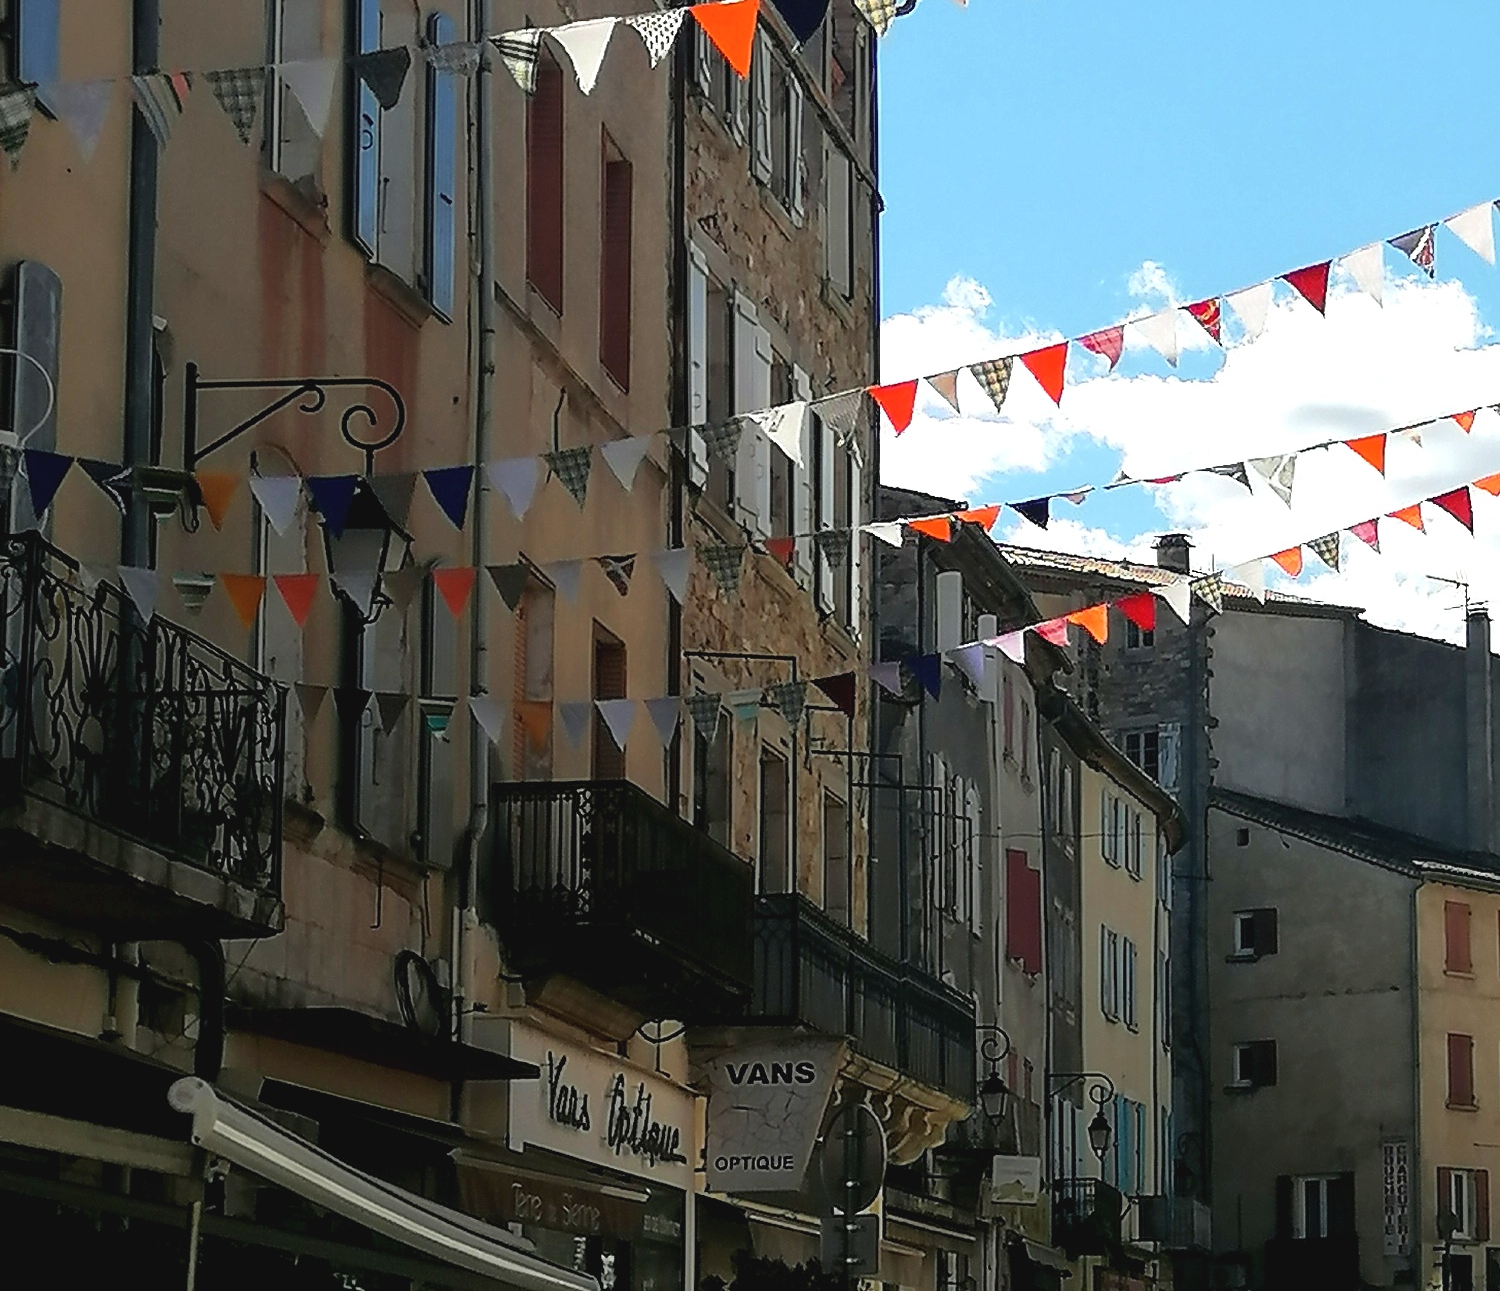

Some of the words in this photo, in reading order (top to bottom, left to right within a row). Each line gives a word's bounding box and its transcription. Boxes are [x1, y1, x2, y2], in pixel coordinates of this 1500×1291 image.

[726, 1062, 815, 1085] VANS
[548, 1050, 590, 1131] Vans
[608, 1073, 687, 1167] Optique
[714, 1156, 794, 1171] OPTIQUE
